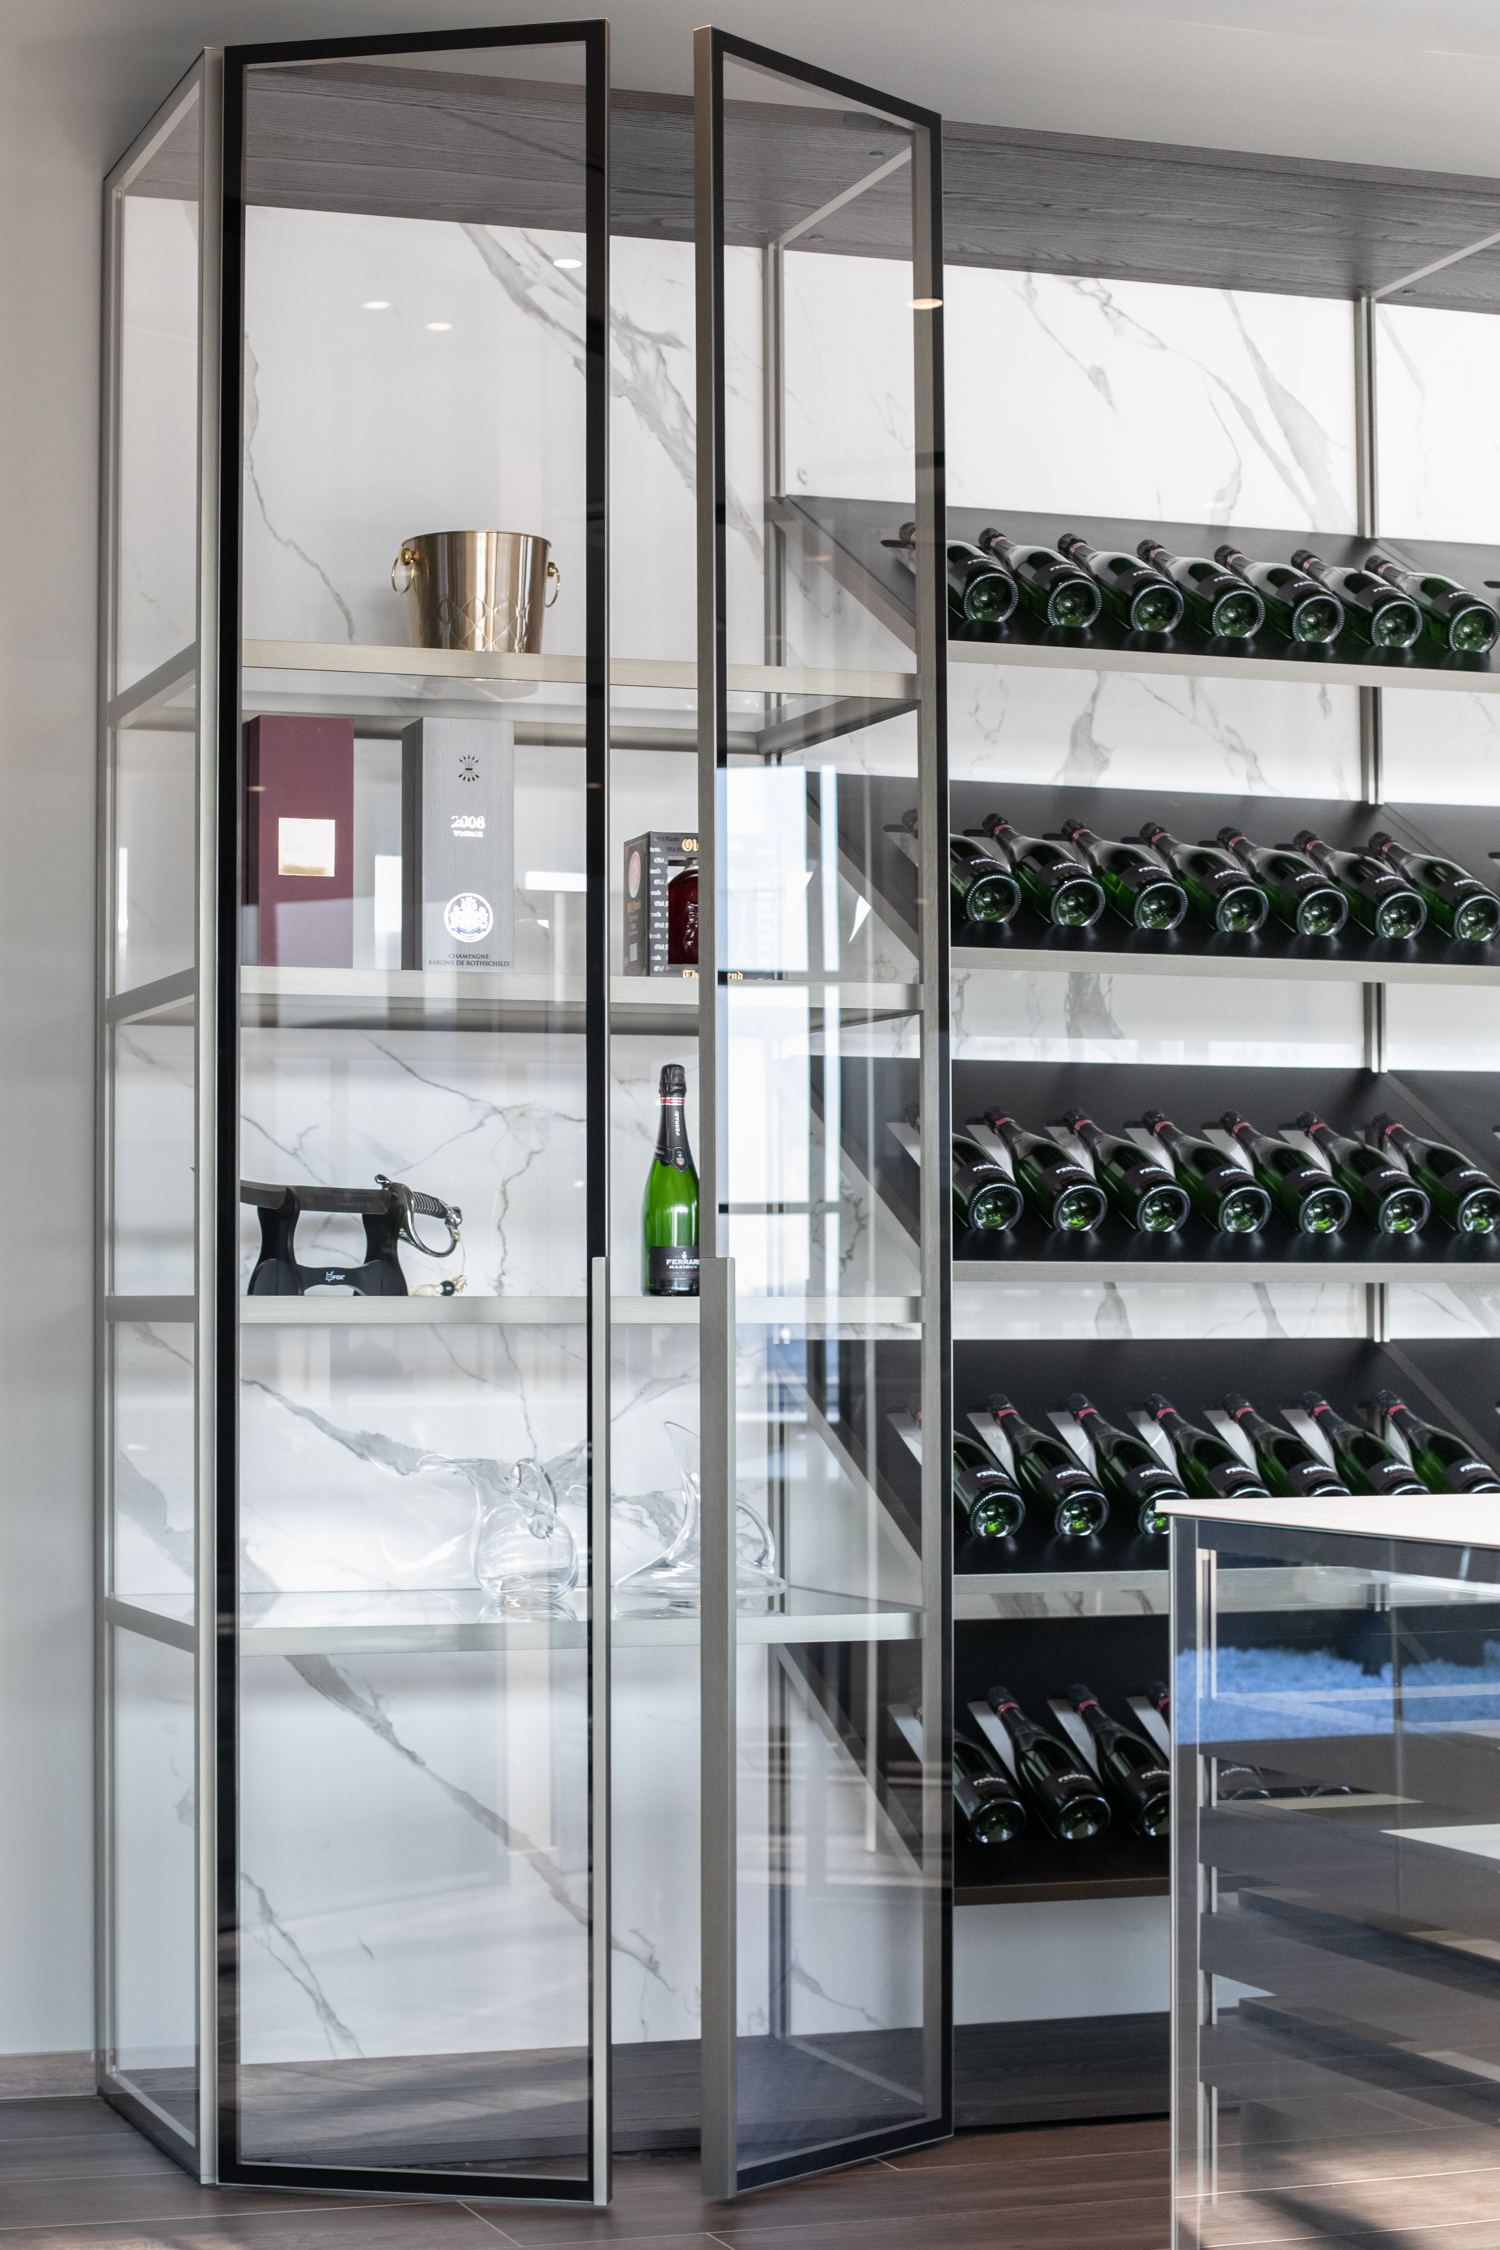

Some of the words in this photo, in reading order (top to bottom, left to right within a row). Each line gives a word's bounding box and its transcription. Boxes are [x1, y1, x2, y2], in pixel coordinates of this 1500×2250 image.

[450, 815, 486, 829] 2008
[682, 969, 699, 979] Th
[727, 971, 744, 980] end
